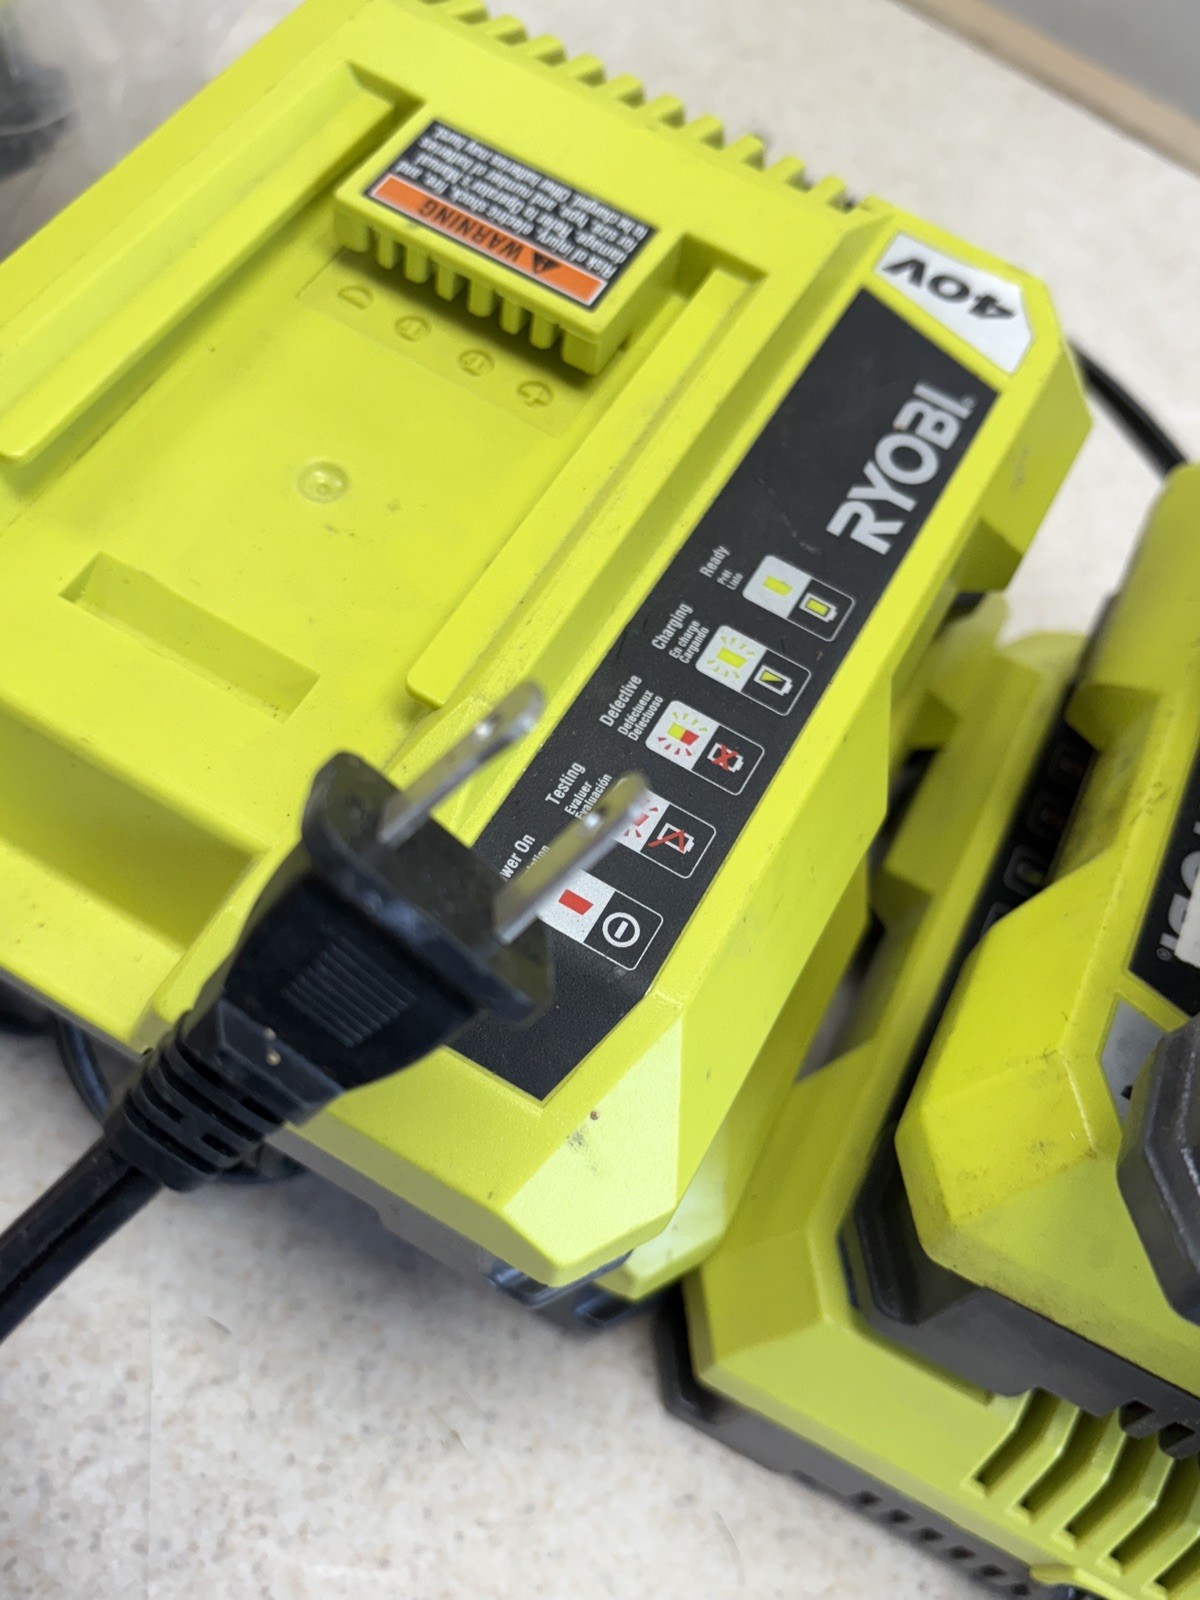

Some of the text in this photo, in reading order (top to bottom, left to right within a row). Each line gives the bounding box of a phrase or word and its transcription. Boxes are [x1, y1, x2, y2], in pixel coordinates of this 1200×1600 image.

[413, 152, 464, 182] Manual
[416, 136, 475, 170] batteries
[462, 141, 494, 162] may
[393, 159, 424, 180] and
[469, 162, 488, 177] of
[482, 169, 534, 200] number
[486, 153, 541, 186] batteries
[528, 191, 558, 212] and
[534, 177, 573, 203] Other
[482, 205, 535, 237] electric
[519, 205, 540, 221] to
[533, 212, 574, 238] Refer
[614, 217, 636, 234] be
[417, 198, 524, 262] WARNING
[614, 234, 638, 252] for
[628, 224, 649, 240] to
[567, 248, 589, 264] of
[581, 254, 617, 279] Risk
[883, 258, 1016, 320] 40V
[825, 382, 972, 556] RYOBI
[700, 546, 729, 577] Ready
[652, 604, 693, 649] Charging
[669, 621, 701, 658] En charge
[678, 627, 709, 663] Cargando
[599, 676, 642, 726] Defective
[627, 696, 663, 741] Defectuoso
[545, 763, 586, 804] Testing
[564, 781, 592, 815] Evaluer
[574, 774, 612, 822] Evaluación
[516, 831, 537, 855] On
